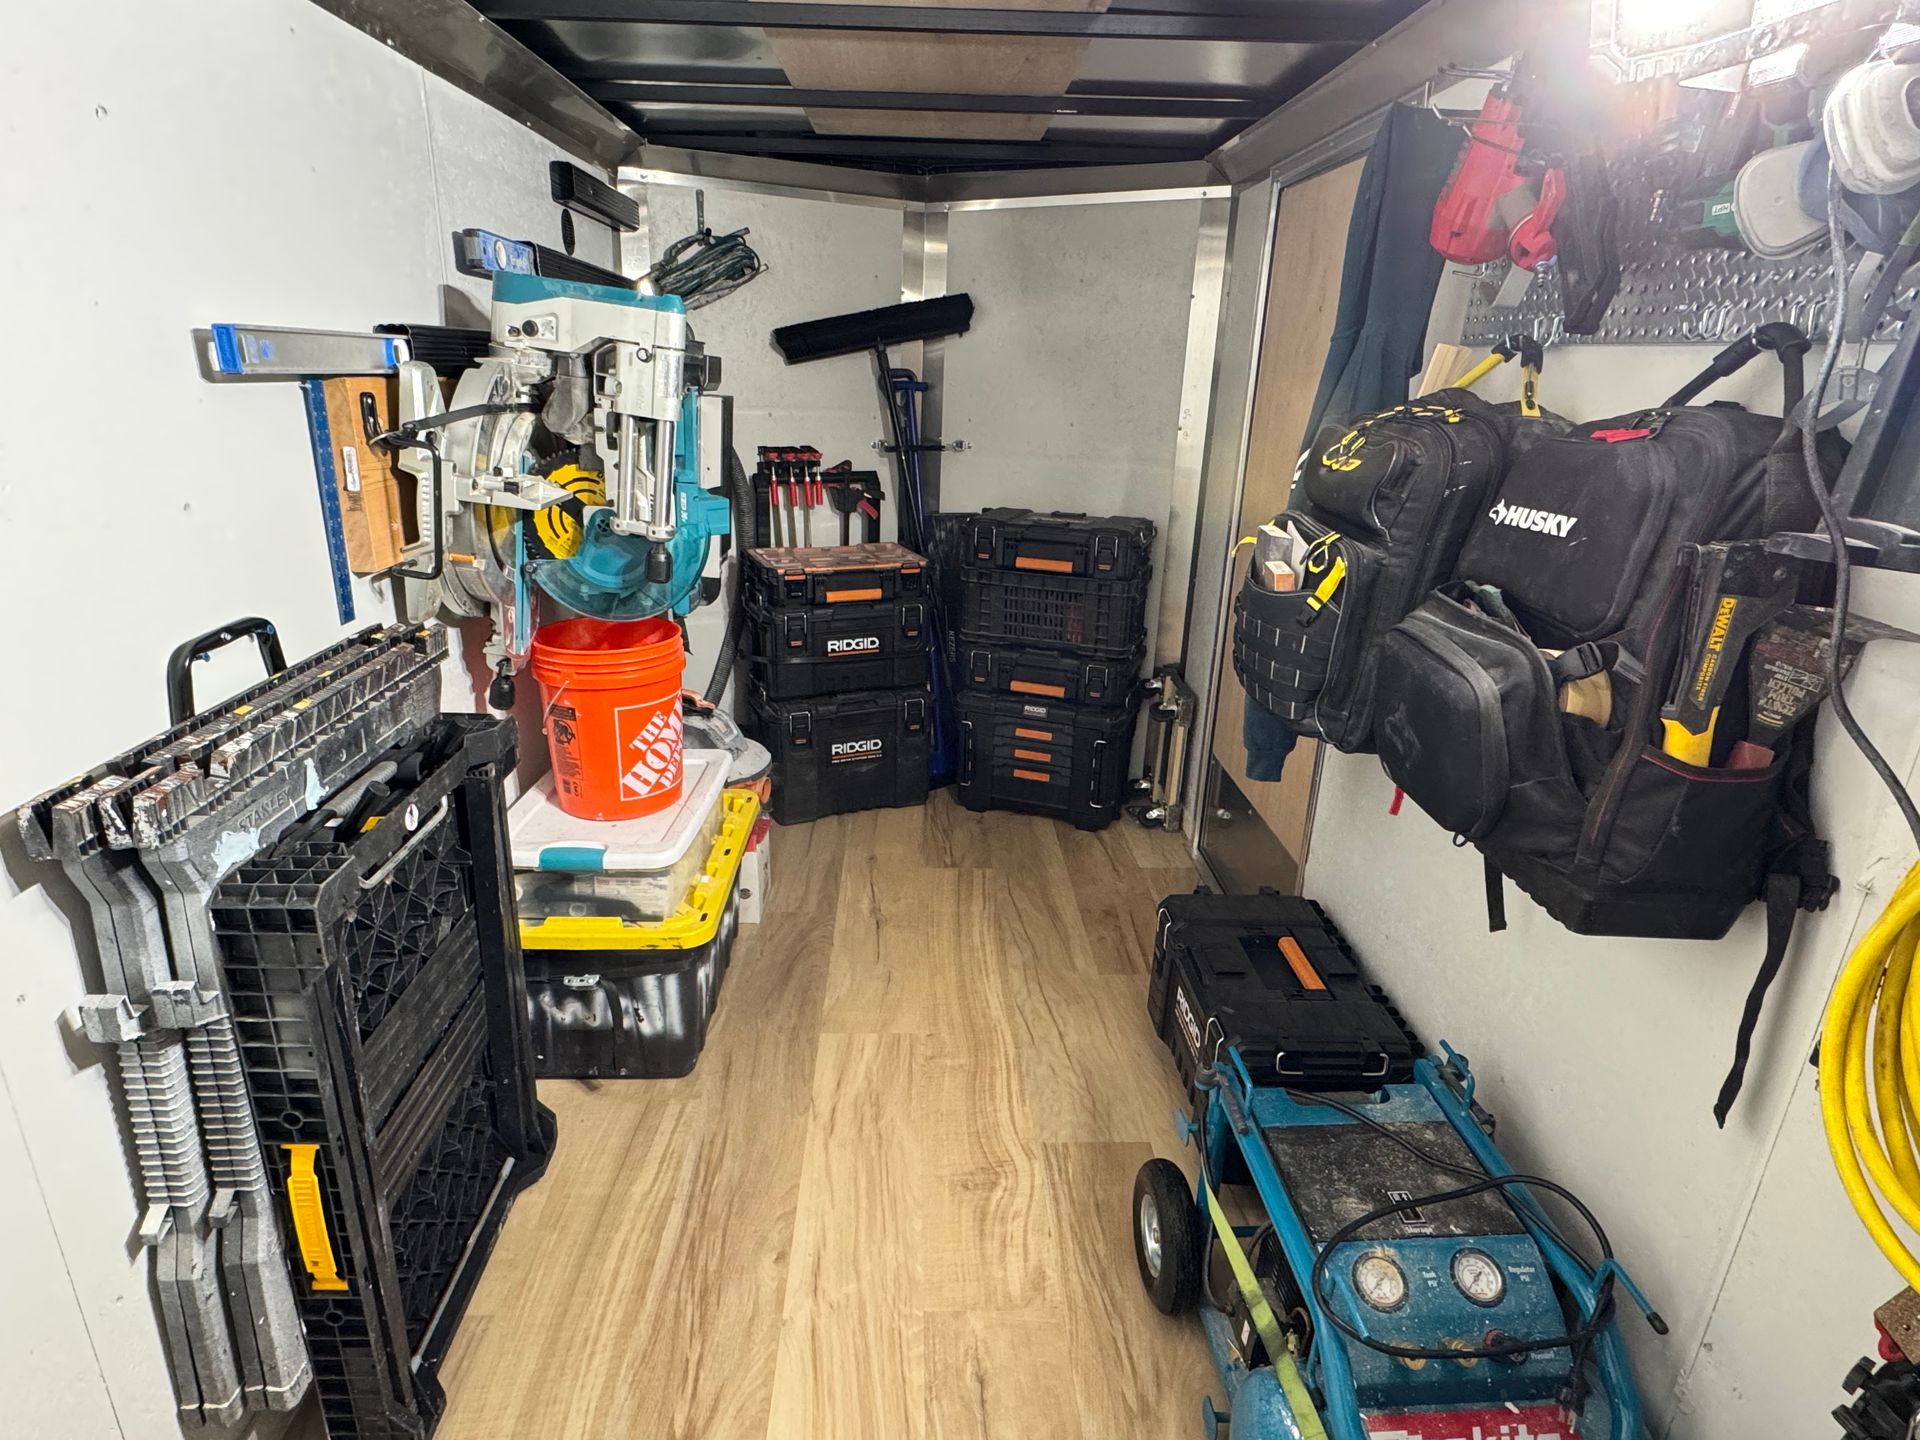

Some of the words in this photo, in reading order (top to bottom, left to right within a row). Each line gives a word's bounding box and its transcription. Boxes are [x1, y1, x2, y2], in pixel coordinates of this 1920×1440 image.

[1504, 505, 1578, 537] HUSKY
[827, 637, 880, 652] RIDGID
[629, 710, 668, 752] THE
[832, 739, 882, 755] RIDGID
[659, 740, 682, 789] DEP
[238, 785, 292, 832] STANLEY
[1177, 985, 1200, 1048] RIDGID
